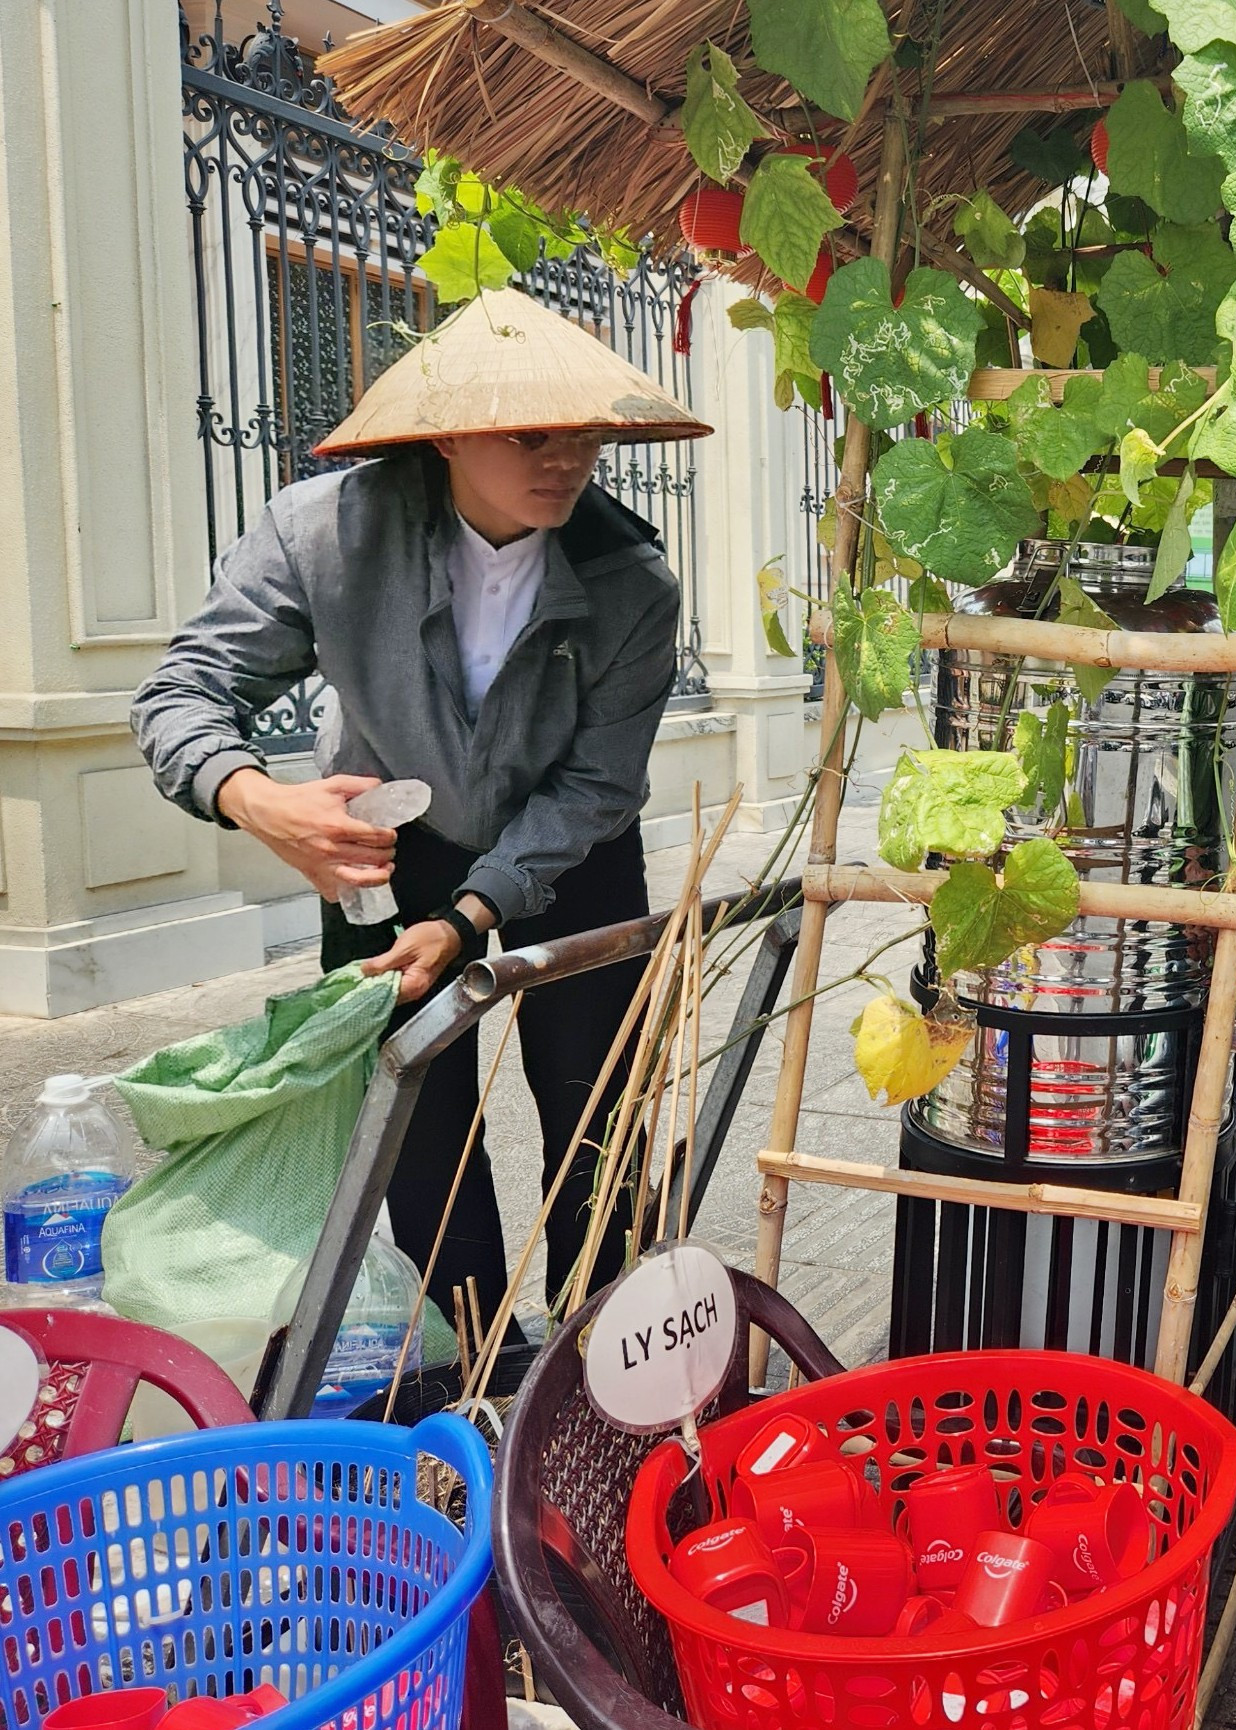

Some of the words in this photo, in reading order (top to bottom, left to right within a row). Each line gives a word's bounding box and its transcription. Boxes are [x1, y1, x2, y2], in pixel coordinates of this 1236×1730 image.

[38, 1223, 85, 1238] AQUAFINA
[621, 1325, 653, 1370] LY
[662, 1293, 718, 1351] SẠCH
[688, 1527, 744, 1556] Colgate
[920, 1548, 964, 1564] Colgate
[976, 1550, 1027, 1572] Colgate
[1077, 1534, 1100, 1580] Colgate
[828, 1564, 849, 1625] Colgate
